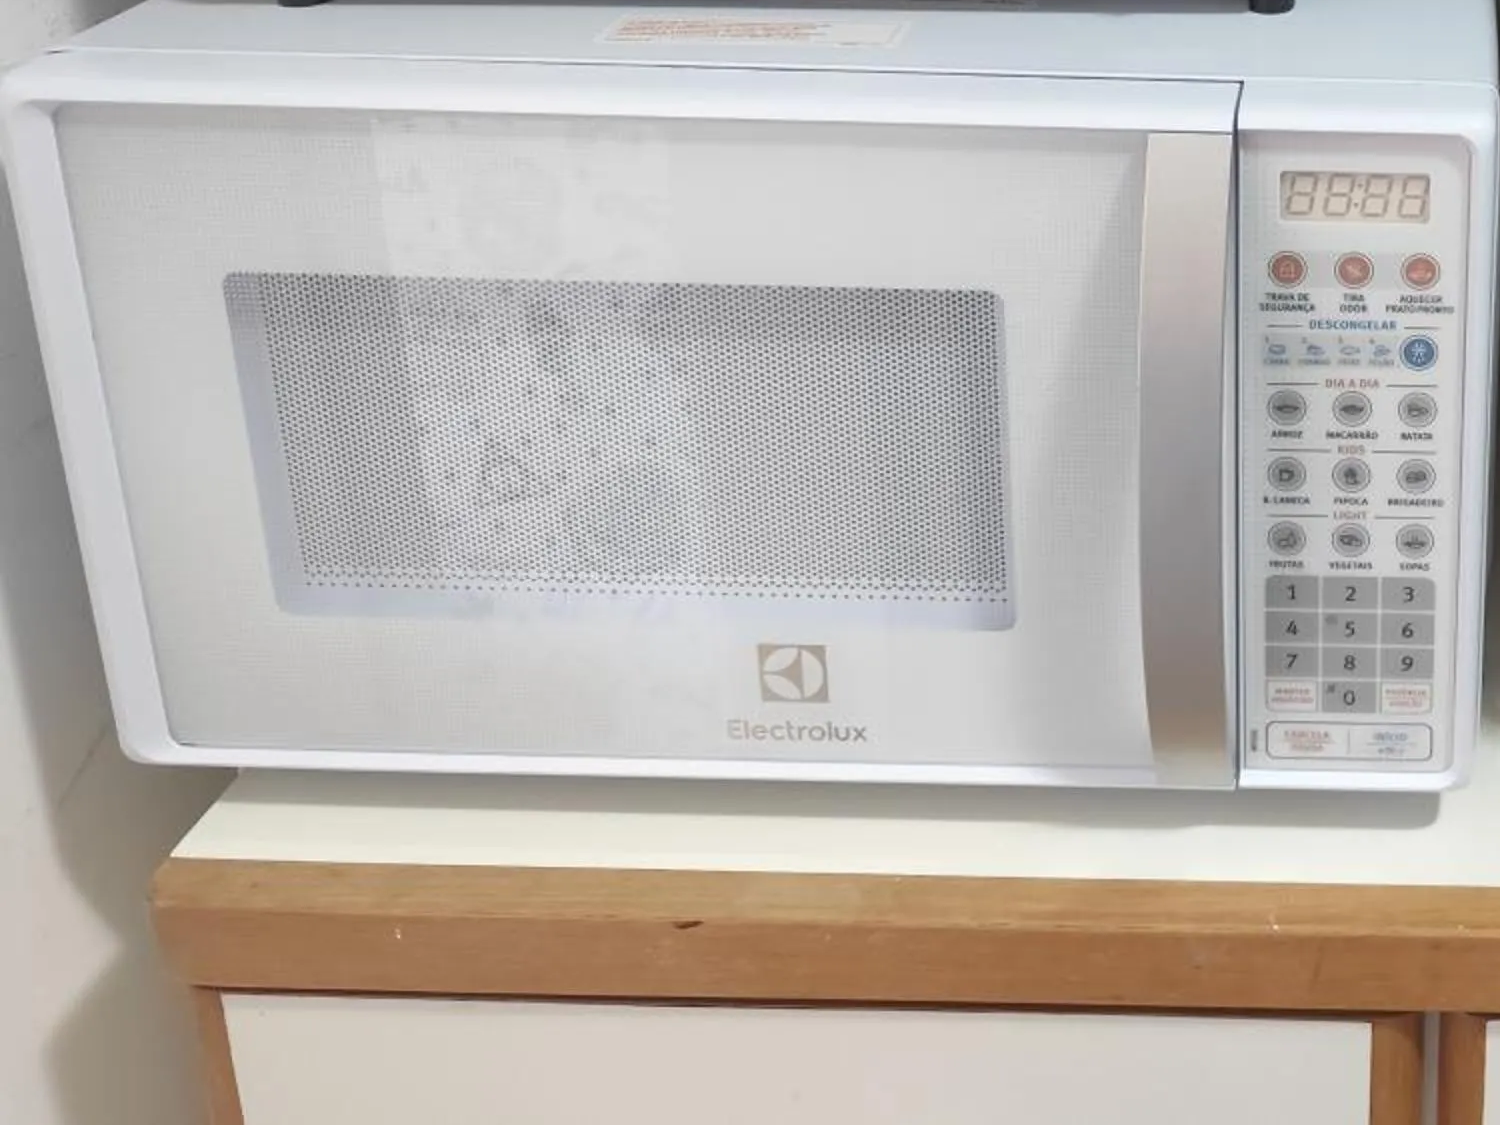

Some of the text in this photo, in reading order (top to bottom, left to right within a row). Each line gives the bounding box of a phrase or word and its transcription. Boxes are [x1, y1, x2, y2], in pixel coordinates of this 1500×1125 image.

[1297, 293, 1310, 302] DE
[1400, 295, 1443, 304] AQUECER
[1259, 303, 1315, 313] SEGURANÇA
[1339, 304, 1368, 313] ODOR
[1309, 319, 1397, 331] DESCONGELAR
[1326, 379, 1380, 388] DIA A DIA
[1338, 445, 1366, 455] KIDS
[1334, 497, 1369, 505] PIPOCA
[1333, 511, 1367, 520] LIGHT
[1329, 561, 1373, 570] VEGETAIS
[1400, 562, 1430, 571] SOPAS
[1288, 585, 1297, 601] 1
[1345, 586, 1357, 602] 2
[1403, 587, 1415, 603] 3
[1286, 621, 1298, 636] 4
[1345, 621, 1356, 638] 5
[1401, 623, 1414, 639] 6
[1286, 653, 1298, 669] 7
[1344, 655, 1356, 671] 8
[1401, 656, 1414, 672] 9
[1343, 690, 1356, 706] 0
[727, 720, 868, 743] Electrolux
